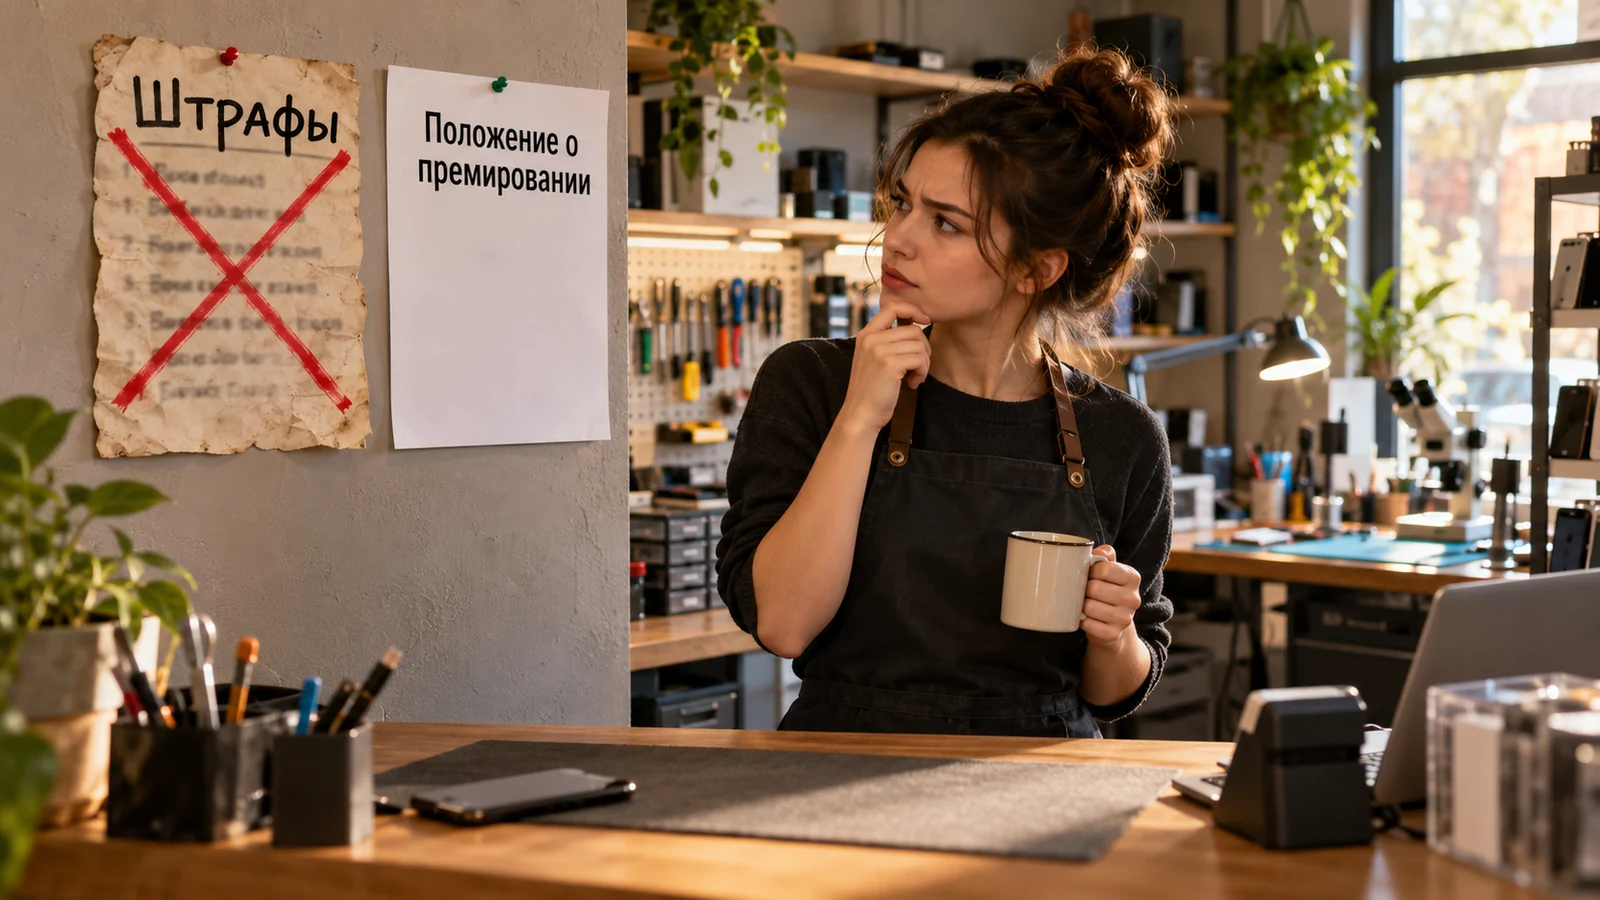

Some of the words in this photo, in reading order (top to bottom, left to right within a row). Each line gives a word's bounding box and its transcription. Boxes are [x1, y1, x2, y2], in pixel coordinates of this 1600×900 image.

[132, 75, 339, 157] Штрафы
[425, 110, 559, 155] Положение
[566, 134, 579, 157] о
[418, 158, 591, 196] премировании
